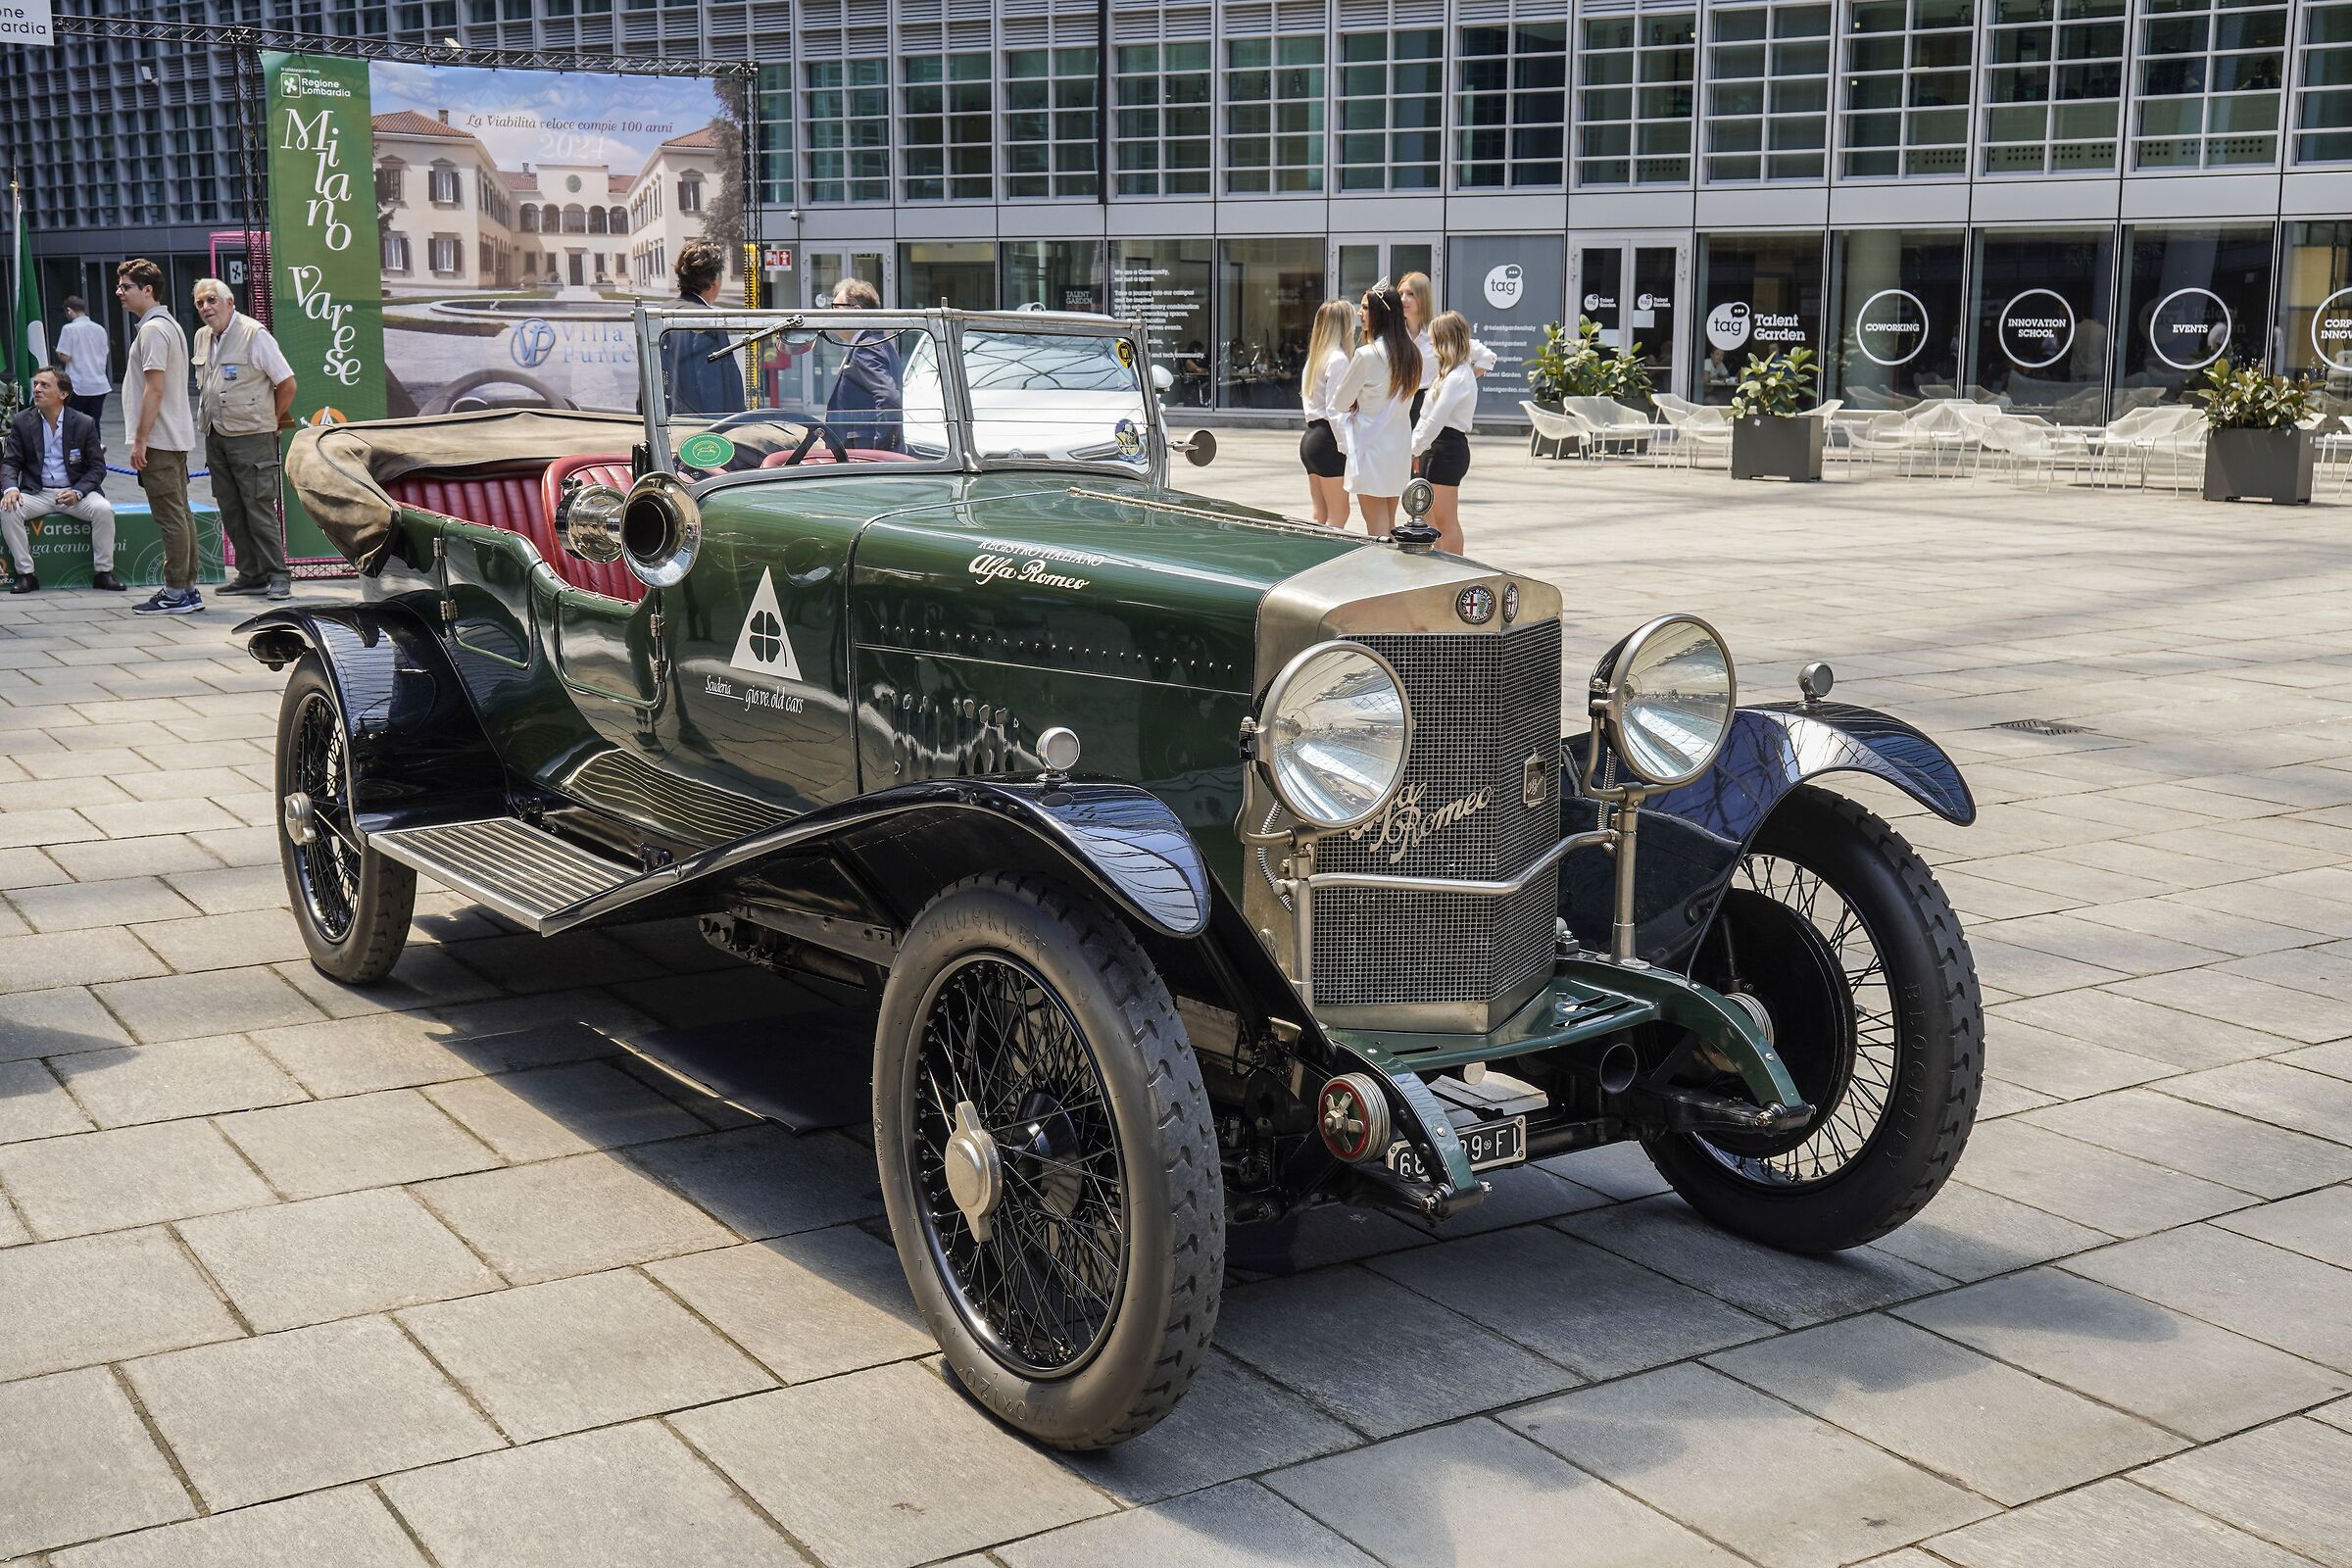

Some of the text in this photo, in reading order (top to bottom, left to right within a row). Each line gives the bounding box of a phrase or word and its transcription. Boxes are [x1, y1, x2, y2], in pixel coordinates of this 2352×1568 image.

[0, 8, 24, 18] ne
[302, 78, 339, 88] Regione
[303, 86, 351, 97] Lombardia
[466, 114, 674, 133] La Viabilità veloce compie 100 anni
[280, 109, 352, 251] Milano
[1491, 278, 1517, 295] tag
[288, 266, 362, 385] Varese
[1714, 318, 1742, 336] tag
[1754, 314, 1799, 326] Talent
[1865, 322, 1920, 332] COWORKING
[2007, 318, 2067, 328] INNOVATION
[2325, 318, 2352, 328] CORP
[562, 323, 623, 342] Villa
[1753, 327, 1806, 341] Garden
[2018, 328, 2055, 338] SCHOOL
[2172, 324, 2209, 334] EVENTS
[54, 541, 90, 554] cento
[978, 539, 1104, 566] REGISTRO ITALIANO
[968, 554, 1091, 590] Alfa Romeo
[706, 674, 732, 695] Scuderia
[785, 695, 804, 714] cars
